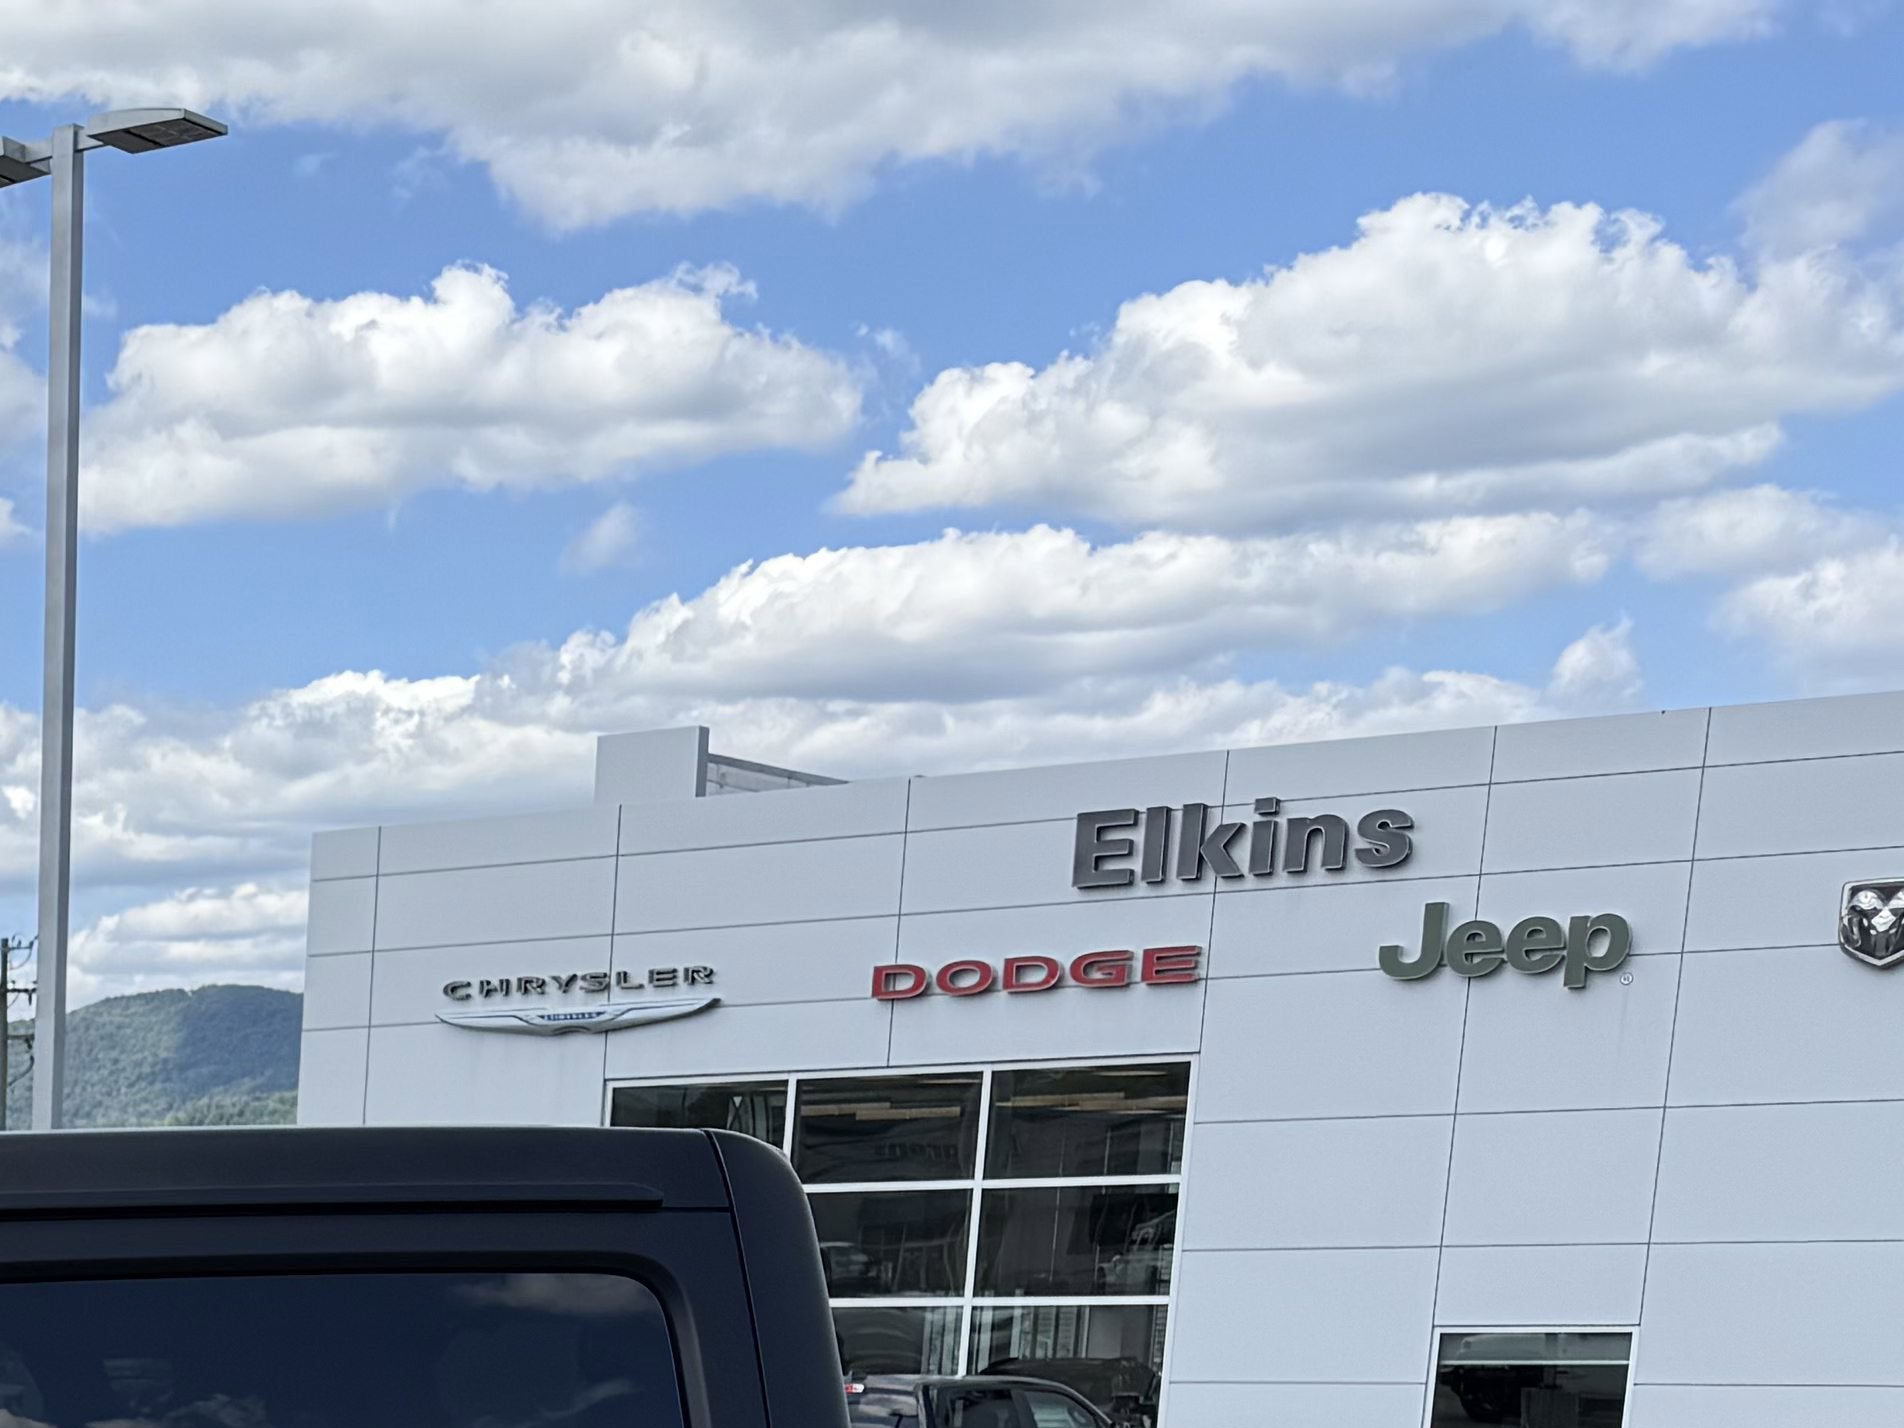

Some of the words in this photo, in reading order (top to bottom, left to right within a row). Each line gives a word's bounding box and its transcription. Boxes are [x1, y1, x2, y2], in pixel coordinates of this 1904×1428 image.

[1071, 796, 1415, 889] Elkins
[871, 945, 1203, 1000] DODGE
[1378, 901, 1633, 990] Jeep
[442, 965, 715, 1000] CHRYSLER
